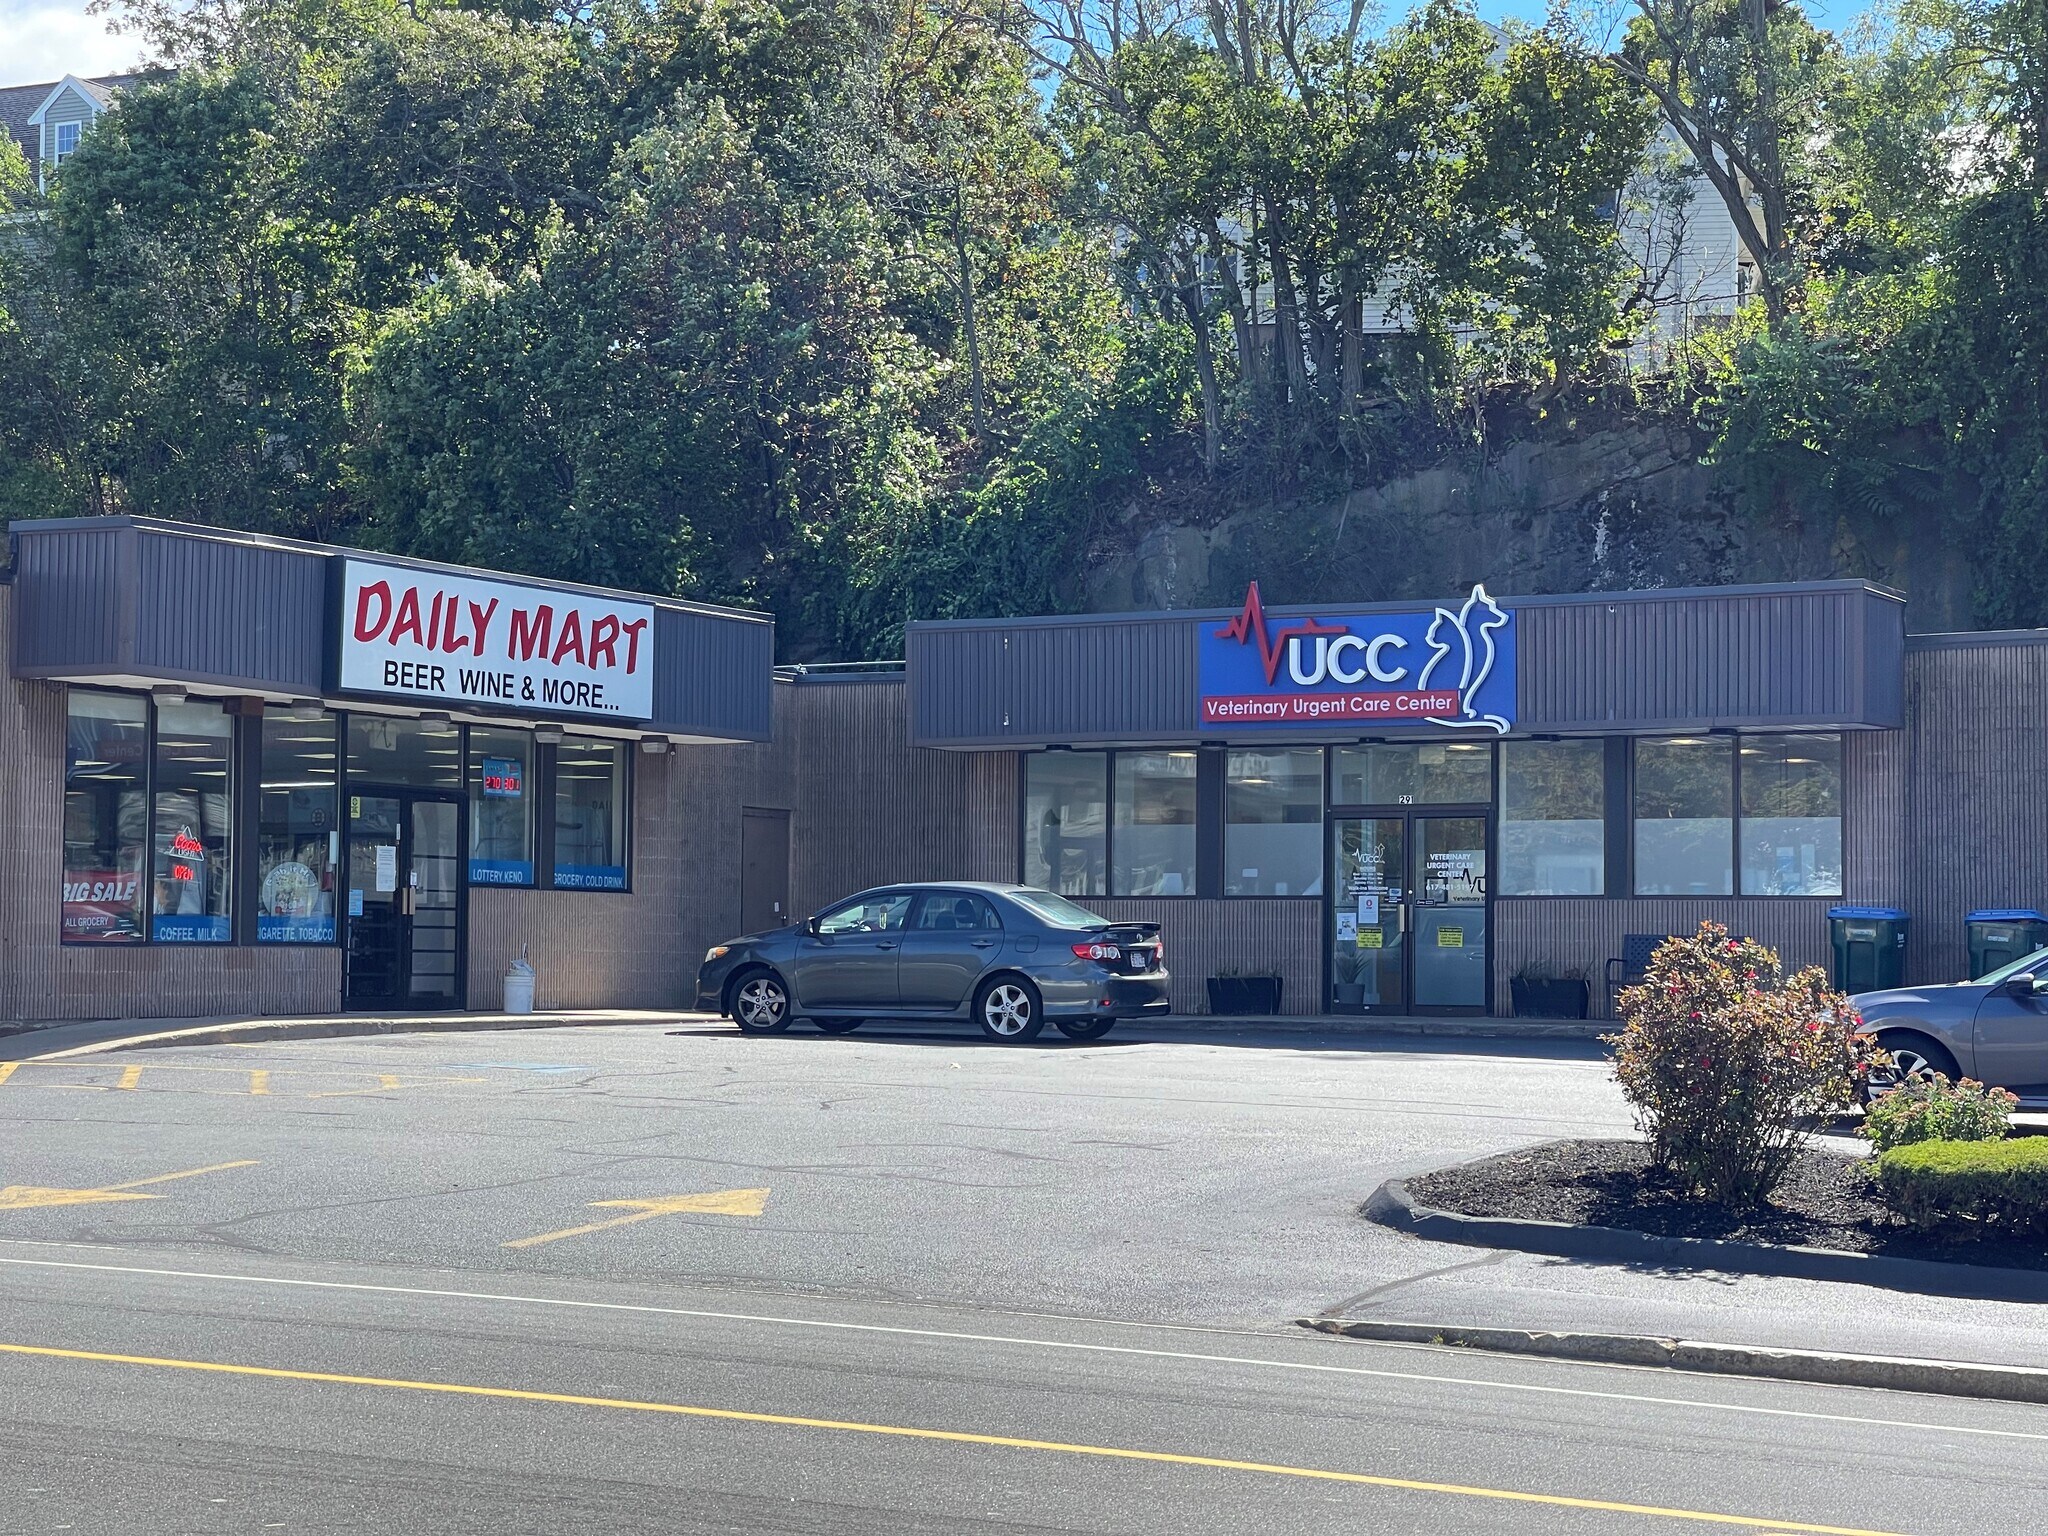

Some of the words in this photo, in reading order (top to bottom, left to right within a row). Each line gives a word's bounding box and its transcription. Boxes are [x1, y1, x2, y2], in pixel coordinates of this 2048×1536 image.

[354, 579, 499, 657] DAILY
[508, 604, 648, 675] MART
[383, 660, 446, 692] BEER
[459, 668, 514, 699] WINE
[521, 676, 535, 701] &
[543, 678, 620, 711] MORE...
[1207, 699, 1289, 716] Veterinary
[1293, 697, 1346, 715] Urgent
[1350, 696, 1391, 712] Care
[1395, 694, 1453, 711] Center
[485, 776, 501, 789] 270
[504, 778, 520, 790] 301
[1399, 795, 1414, 804] 291
[175, 834, 203, 852] Coors
[1430, 853, 1471, 861] VETERINARY
[174, 865, 194, 880] OPEN
[1437, 870, 1464, 878] CENTER
[585, 874, 602, 887] COLD
[603, 875, 623, 888] DRINK
[63, 882, 90, 902] BIG
[91, 880, 137, 902] SALE
[65, 917, 77, 927] ALL
[78, 916, 109, 927] GROCERY
[159, 927, 196, 941] COFFEE,
[197, 927, 217, 941] MILK
[257, 927, 297, 942] IGARETTE,
[299, 928, 334, 941] TOBACCO
